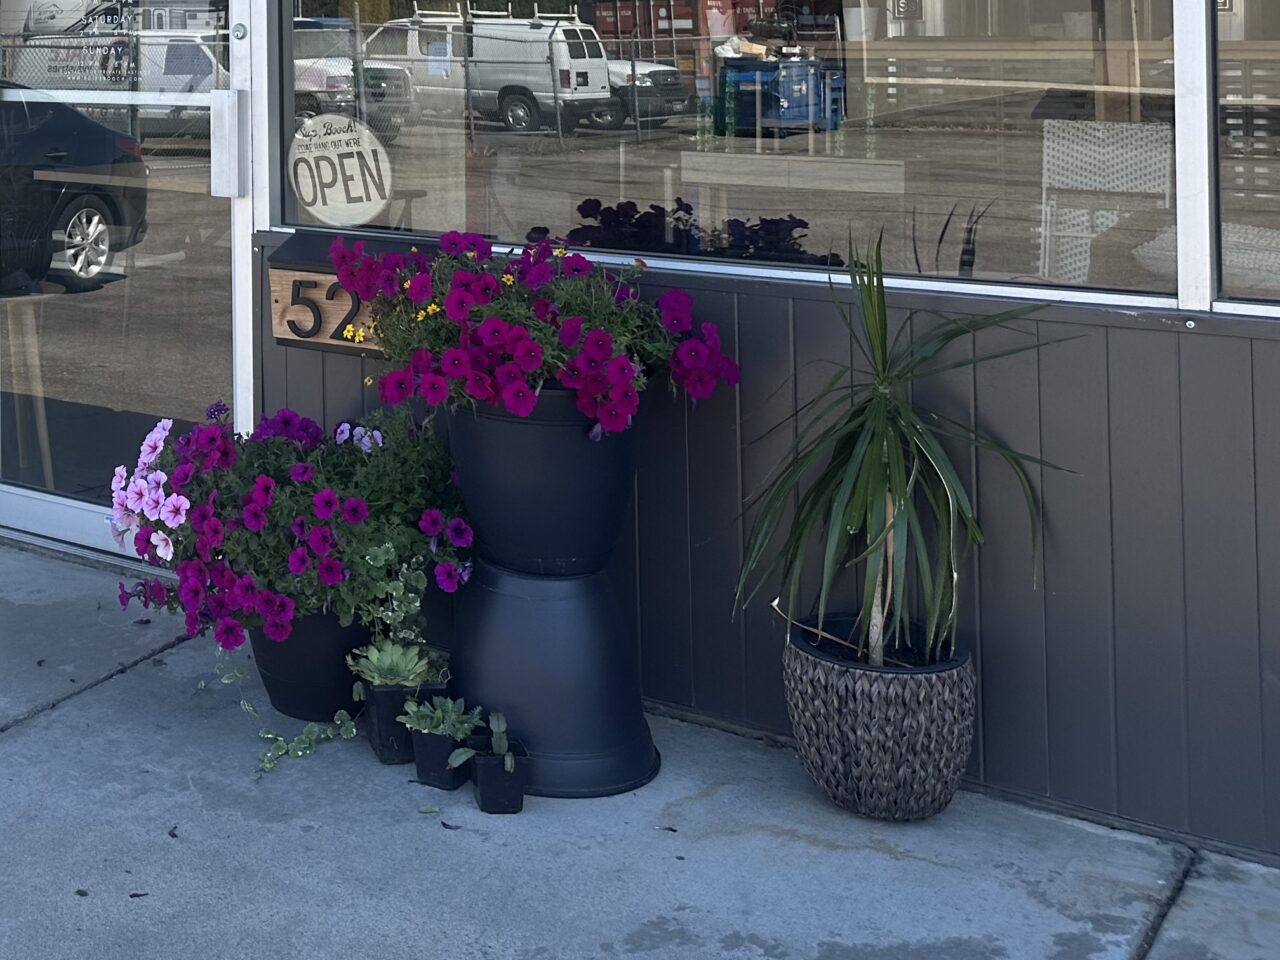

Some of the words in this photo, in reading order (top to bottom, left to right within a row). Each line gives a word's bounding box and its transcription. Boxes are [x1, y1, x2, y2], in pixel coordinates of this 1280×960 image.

[81, 15, 133, 24] SATURDAY
[82, 45, 123, 55] SUNDAY
[322, 119, 358, 137] Booch!
[330, 139, 342, 150] OUT
[292, 147, 388, 208] OPEN
[286, 279, 362, 342] 52
